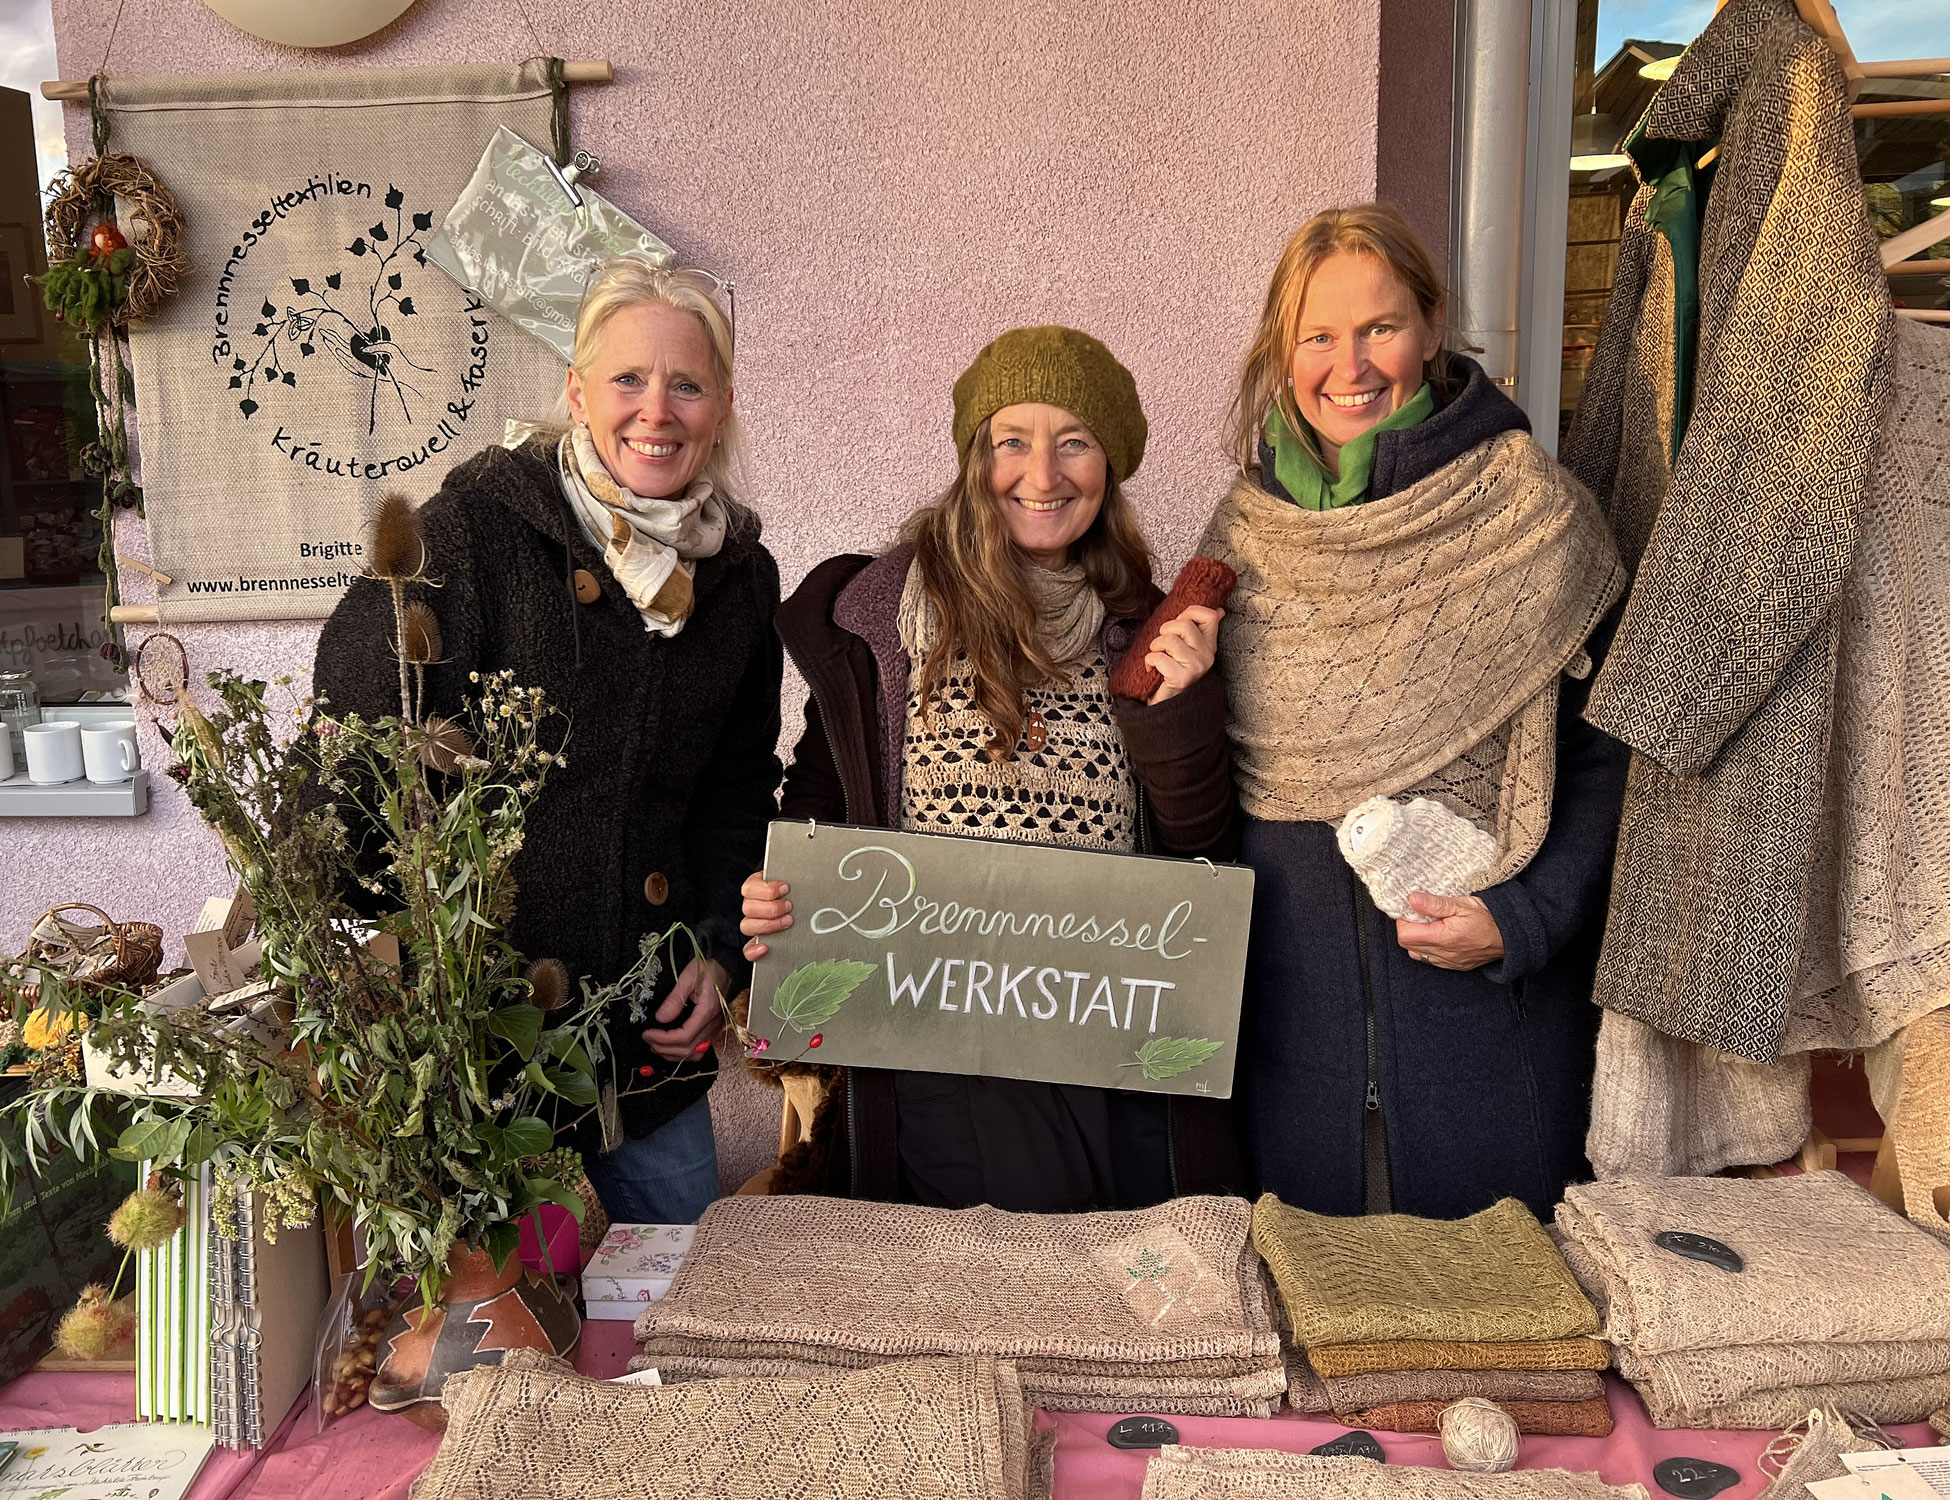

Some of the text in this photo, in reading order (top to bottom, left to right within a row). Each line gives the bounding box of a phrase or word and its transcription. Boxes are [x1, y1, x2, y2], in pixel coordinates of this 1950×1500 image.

[213, 172, 371, 363] Brennnesseltextilien
[522, 231, 556, 260] Bild
[447, 397, 475, 421] &
[461, 286, 489, 393] Faserk
[300, 541, 363, 560] Brigitte
[810, 845, 1208, 960] Brennnessel-
[886, 951, 1176, 1034] WERKSTATT
